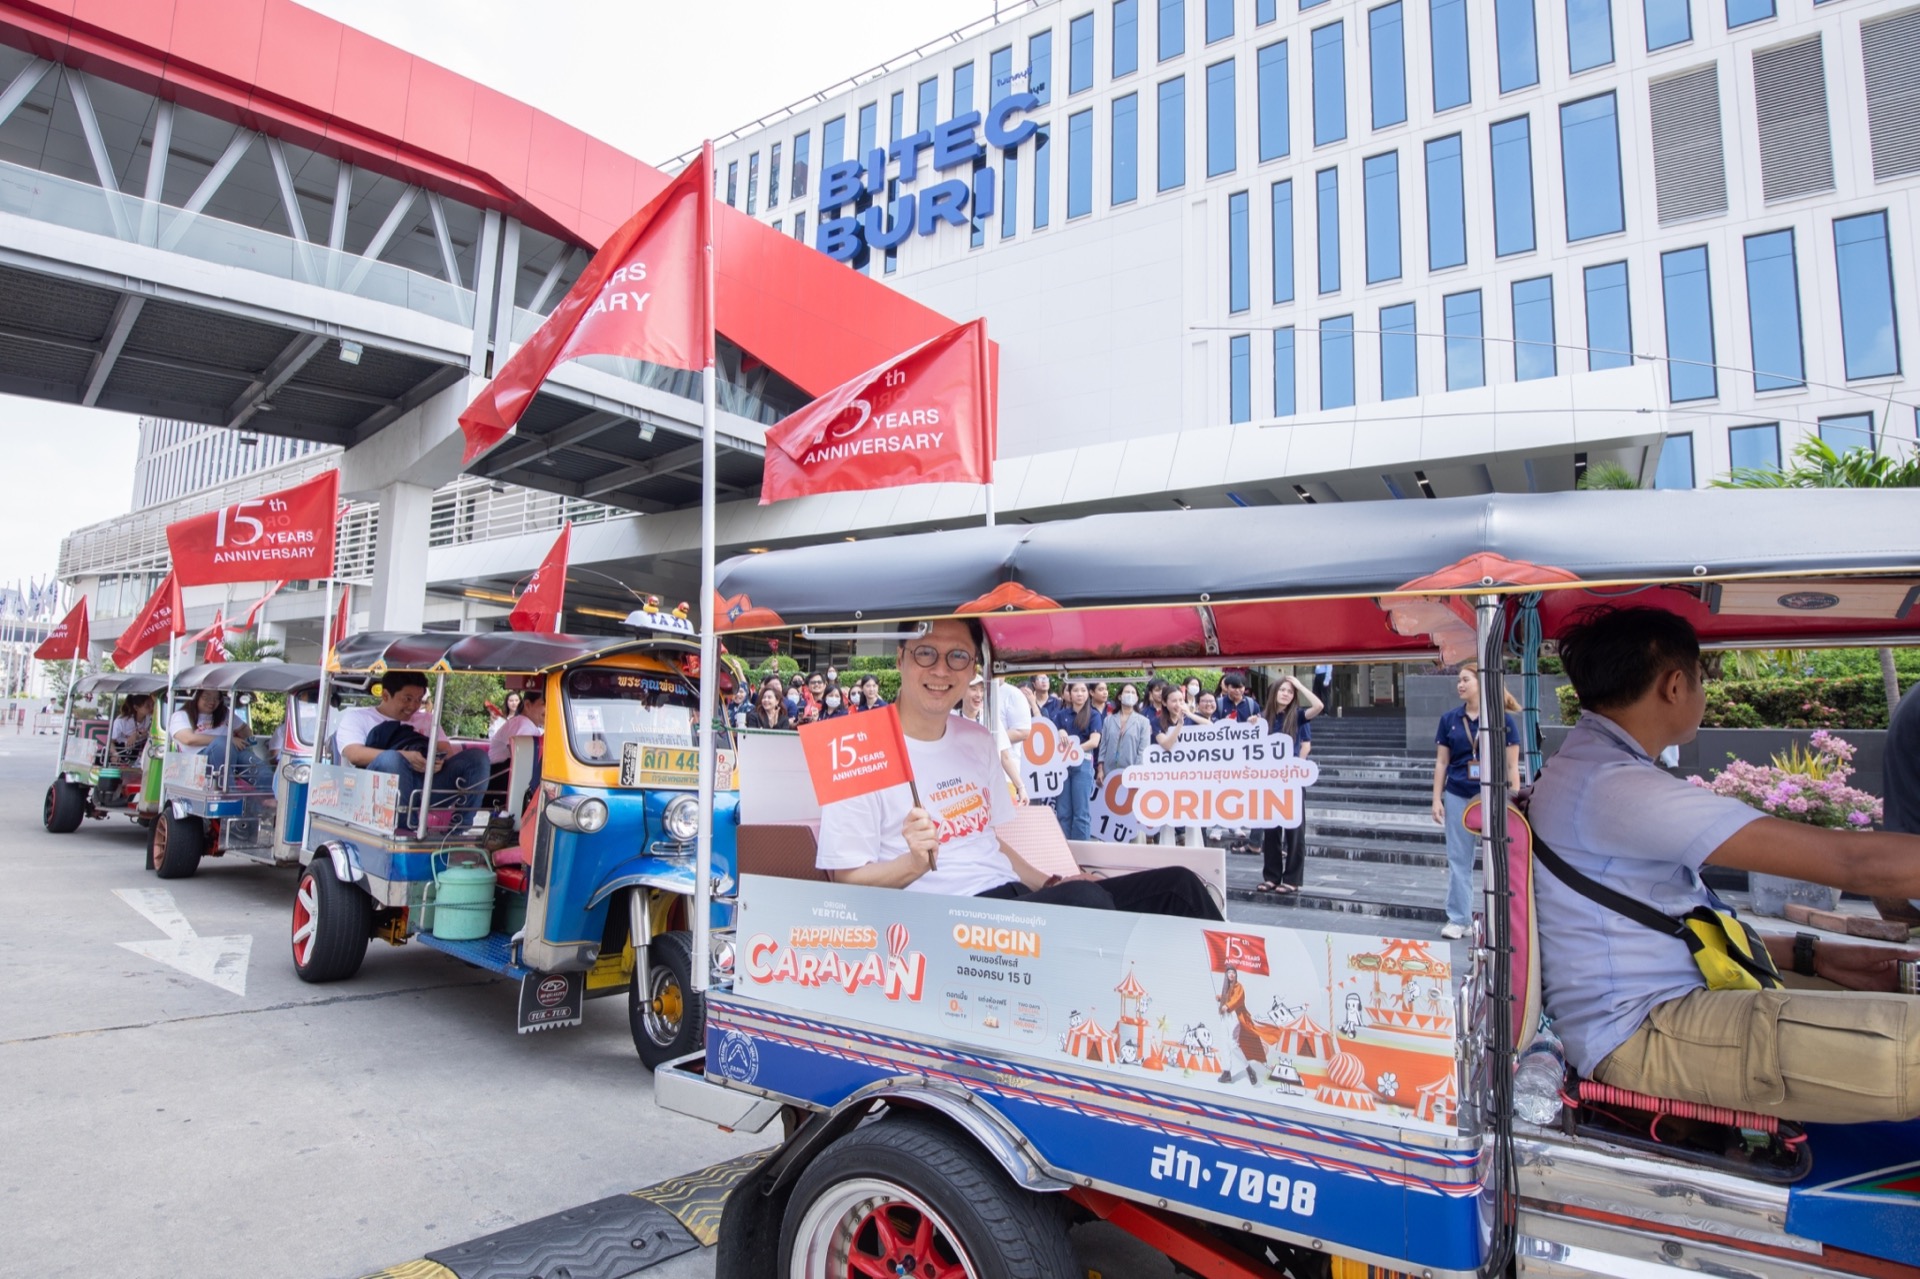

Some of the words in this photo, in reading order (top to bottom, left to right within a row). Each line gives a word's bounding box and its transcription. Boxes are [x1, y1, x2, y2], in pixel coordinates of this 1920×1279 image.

[819, 92, 1040, 212] BITEC
[816, 166, 995, 263] BURI
[872, 408, 940, 430] YEARS
[803, 432, 944, 465] ANNIVERSARY
[266, 531, 314, 544] YEARS
[214, 547, 315, 563] ANNIVERSARY
[648, 612, 690, 631] TAXI
[858, 750, 886, 764] YEARS
[1150, 746, 1234, 764] ฉลองครบ
[1242, 744, 1264, 761] 15
[1271, 741, 1286, 761] ปี
[832, 760, 889, 782] ANNIVERSARY
[1128, 765, 1310, 785] คาราวานความสุขพร้อมอยู่กับ
[936, 776, 962, 791] ORIGIN
[1029, 771, 1039, 792] 1
[929, 782, 978, 802] VERTICAL
[1139, 788, 1294, 821] ORIGIN
[1100, 815, 1109, 834] 1
[812, 907, 858, 921] VERTICAL
[823, 901, 847, 910] ORIGIN
[791, 927, 877, 949] HAPPINESS
[952, 923, 1041, 958] ORIGIN
[745, 933, 926, 1002] CARAVAN
[1224, 958, 1262, 969] ANNIVERSARY
[1244, 954, 1261, 962] YEARS
[956, 965, 1004, 981] ฉลองครบ
[1008, 972, 1020, 984] 15
[1023, 972, 1031, 985] ปี
